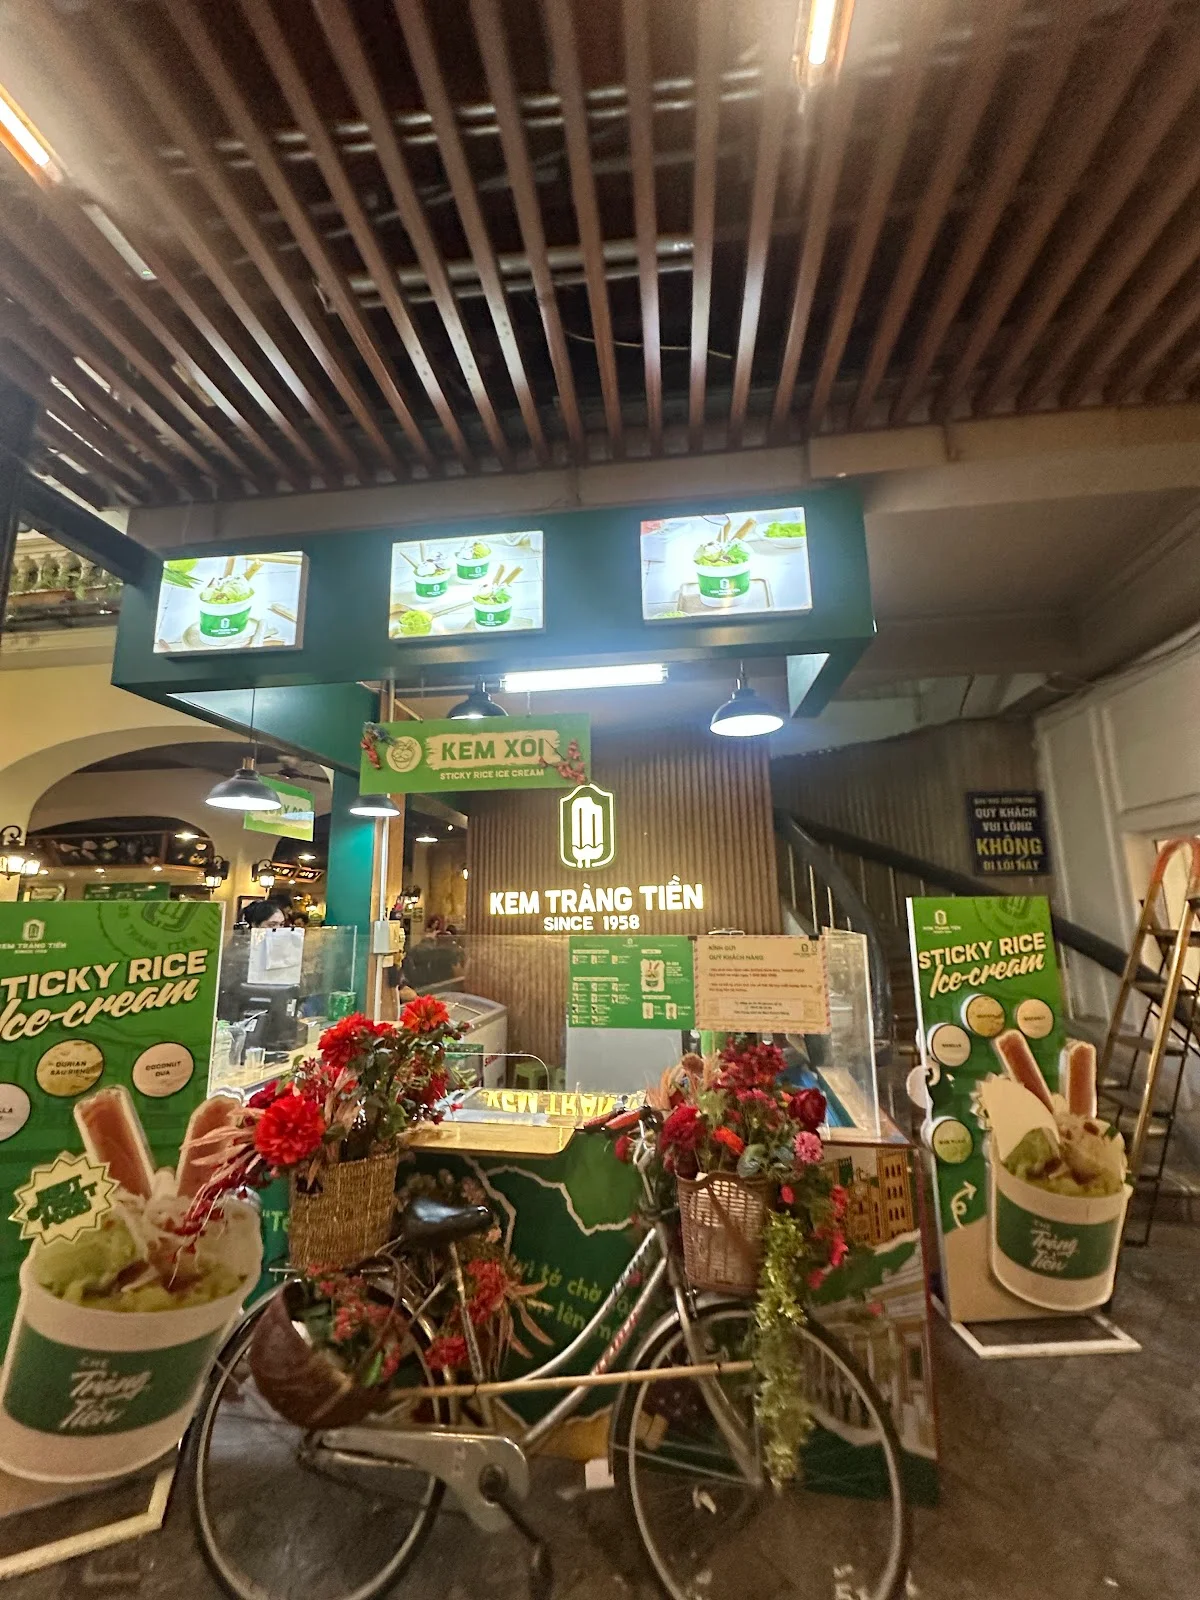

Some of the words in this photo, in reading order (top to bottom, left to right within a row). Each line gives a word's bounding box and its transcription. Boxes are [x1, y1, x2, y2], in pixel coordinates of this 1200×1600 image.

[442, 740, 496, 761] KEM
[504, 735, 545, 758] XÔI
[474, 771, 494, 779] RICE
[495, 770, 509, 778] ICE
[511, 769, 545, 778] CREAM
[1000, 805, 1037, 818] KHÁCH
[982, 821, 1000, 832] VUI
[976, 834, 1044, 856] KHÔNG
[490, 890, 540, 915] KEM
[544, 882, 633, 913] TRÀNG
[639, 875, 704, 911] TIỀN
[543, 915, 594, 931] SINCE
[602, 914, 640, 931] 1958
[918, 940, 993, 969] STICKY
[999, 932, 1047, 956] RICE
[128, 949, 208, 984] RICE
[929, 953, 1045, 998] Ice-cream
[145, 1060, 182, 1070] COCONUT
